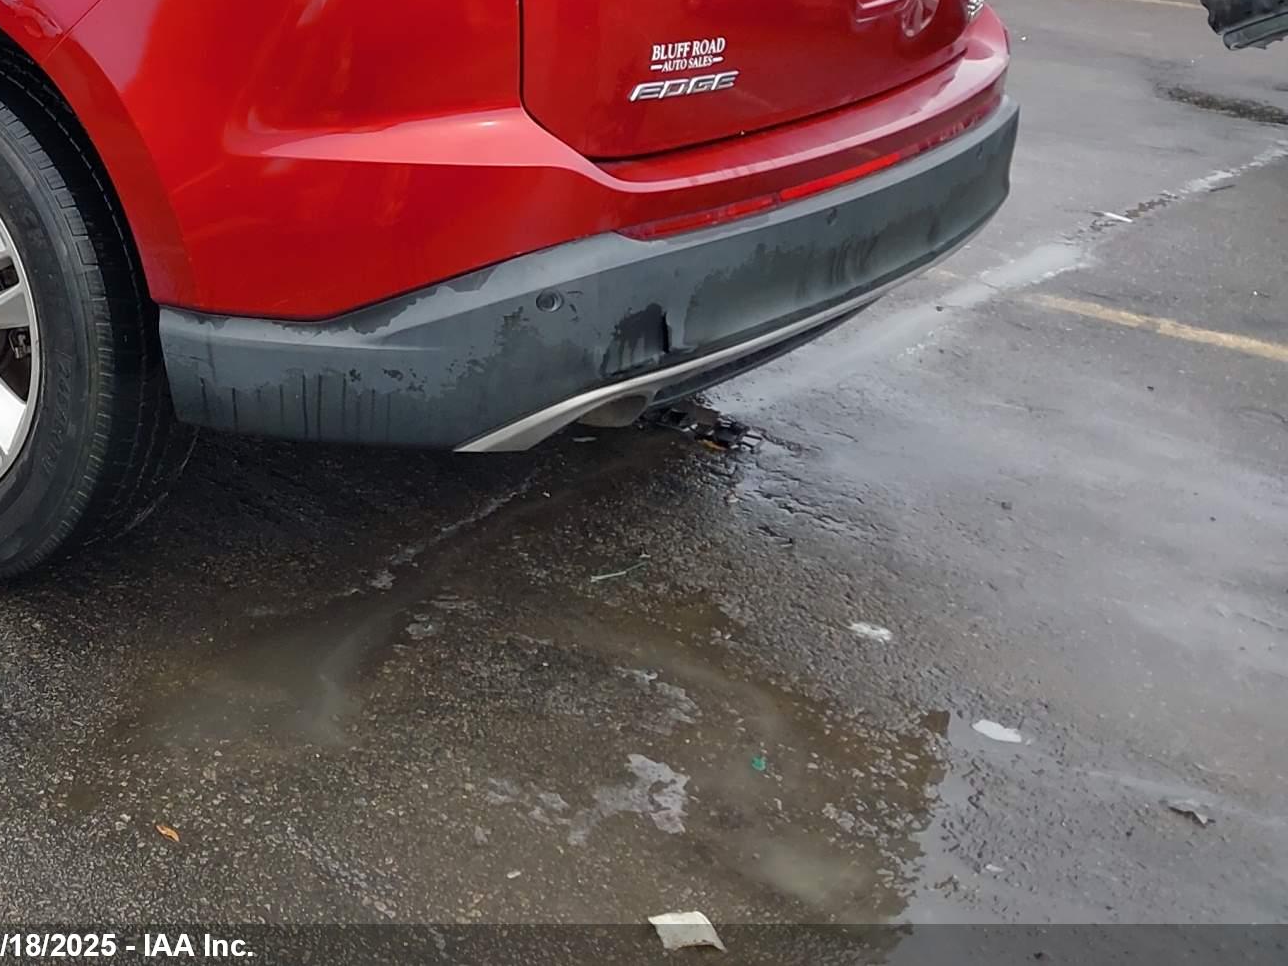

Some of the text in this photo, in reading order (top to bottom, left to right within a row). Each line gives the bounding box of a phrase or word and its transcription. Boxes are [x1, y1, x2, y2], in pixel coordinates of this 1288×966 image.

[651, 37, 726, 62] BLUFF ROAD
[662, 55, 714, 73] AUTO SALES
[629, 70, 740, 102] EDGE
